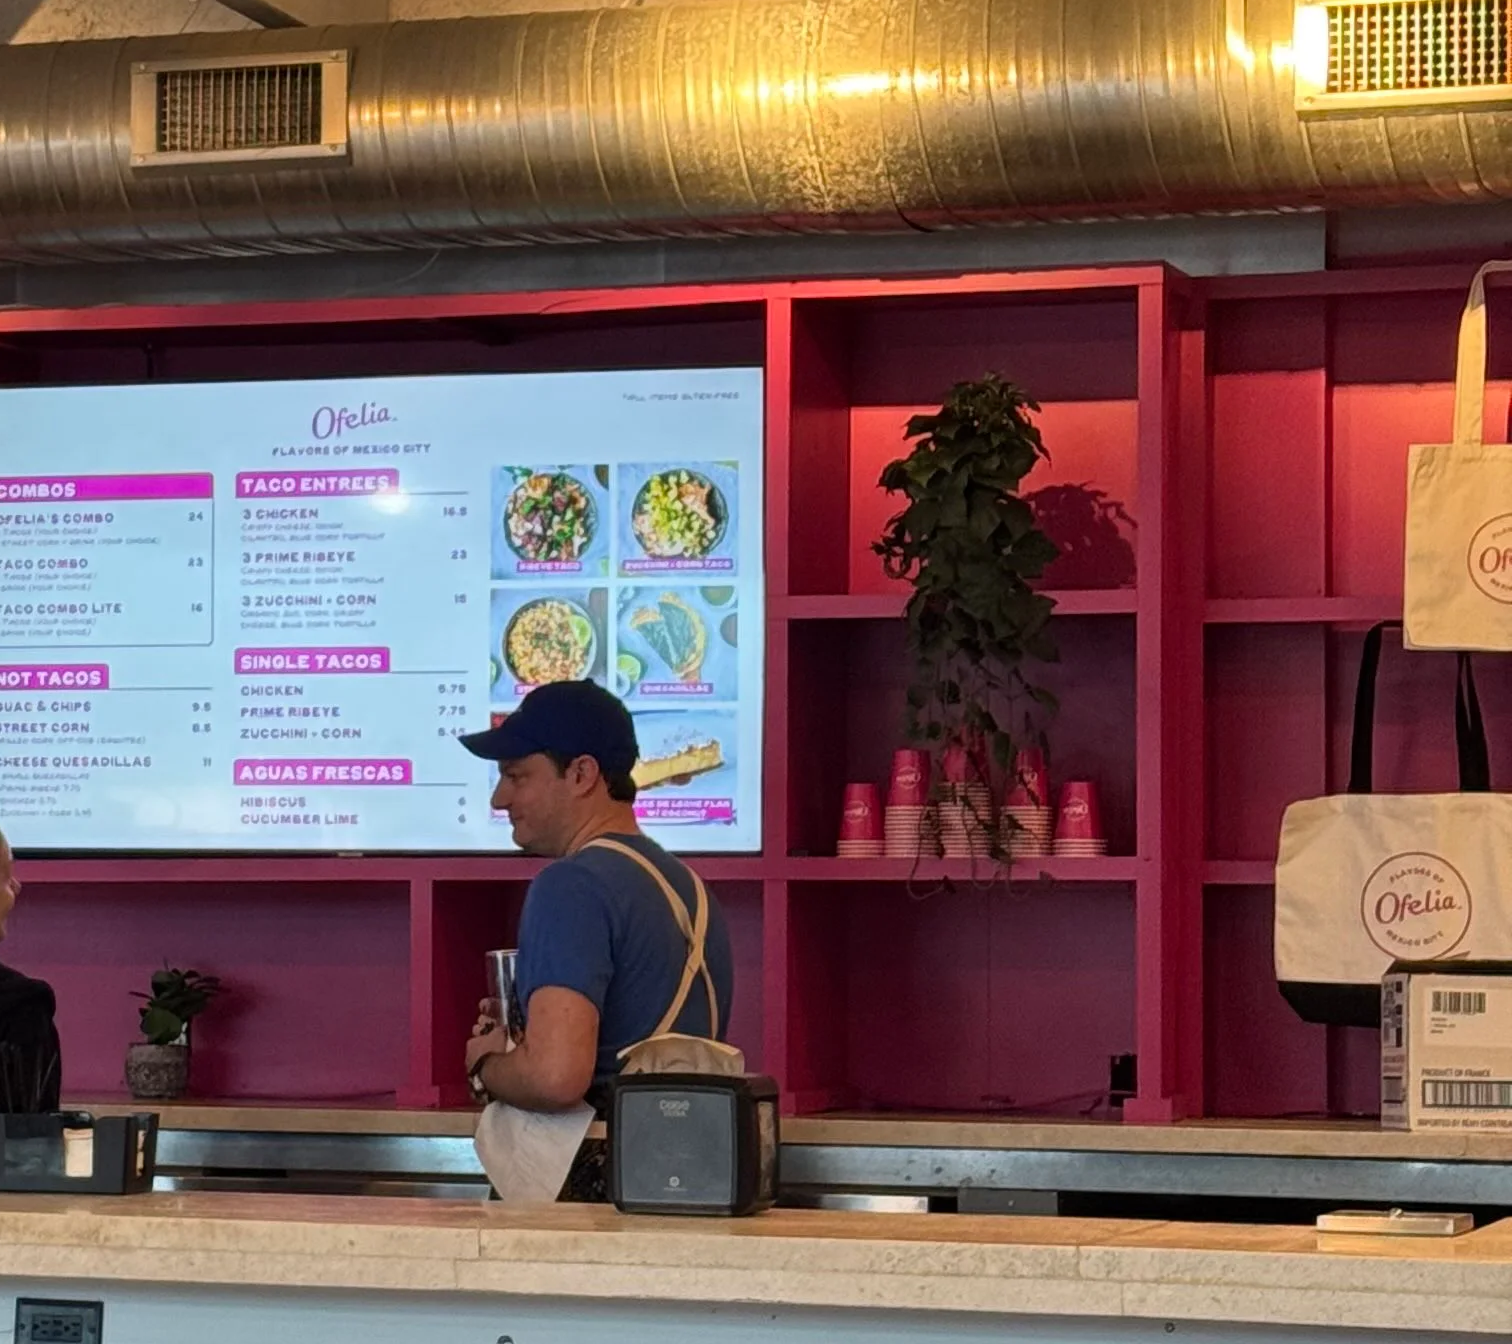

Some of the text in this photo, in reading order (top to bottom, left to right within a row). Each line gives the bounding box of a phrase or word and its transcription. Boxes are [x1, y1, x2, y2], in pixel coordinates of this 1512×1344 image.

[272, 443, 431, 457] FLAVORS OF MEXICO CITY
[241, 474, 390, 494] TACO ENTREES
[63, 512, 115, 524] COMBO
[187, 511, 204, 522] 24
[243, 509, 252, 521] 3
[256, 508, 320, 520] CHICKEN
[37, 558, 89, 569] COMBO
[242, 551, 251, 564] 3
[255, 551, 299, 563] PRIME
[303, 551, 356, 563] RIBEYE
[241, 595, 251, 607] 3
[255, 594, 323, 607] ZUCCHINI
[335, 594, 377, 606] CORN
[37, 603, 89, 615] COMBO
[92, 603, 123, 614] LITE
[240, 653, 382, 671] SINGLE TACOS
[37, 670, 102, 686] TACOS
[240, 685, 304, 697] CHICKEN
[51, 701, 92, 712] CHIPS
[240, 706, 285, 718] PRIME
[287, 706, 341, 718] RIBEYE
[51, 722, 90, 733] CORN
[240, 727, 362, 740] ZUCCHINI CORN
[52, 755, 152, 768] QUESADILLAS
[239, 764, 404, 781] AGUAS FRESCAS
[240, 796, 307, 809] HIBISCUS
[240, 814, 321, 825] CUCUMBER
[324, 814, 359, 825] LIME
